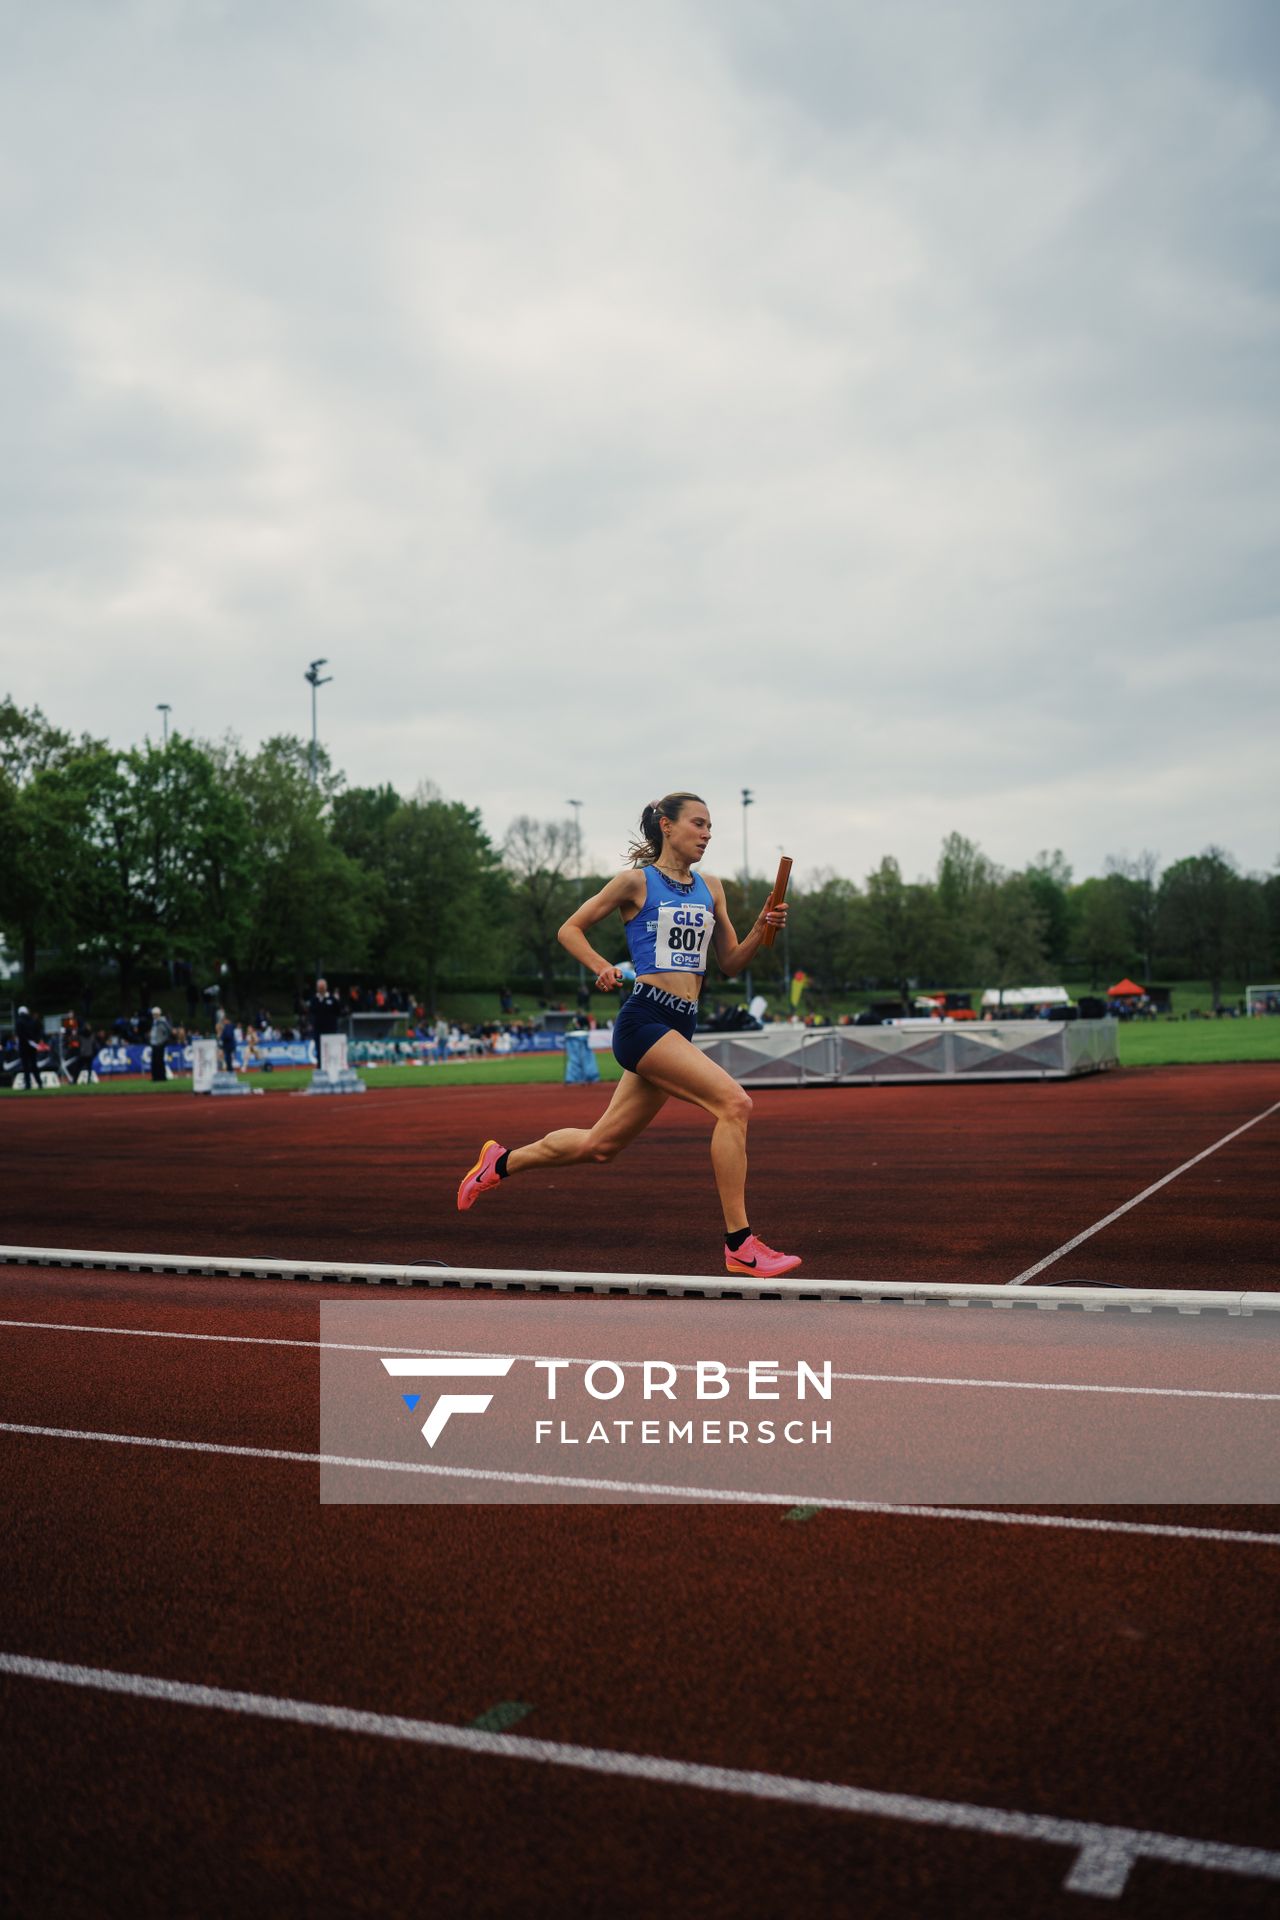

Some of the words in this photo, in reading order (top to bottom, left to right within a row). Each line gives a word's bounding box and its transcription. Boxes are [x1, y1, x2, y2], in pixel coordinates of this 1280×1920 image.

[673, 910, 704, 927] GLS
[668, 927, 705, 951] 801
[646, 986, 689, 1013] NIKE
